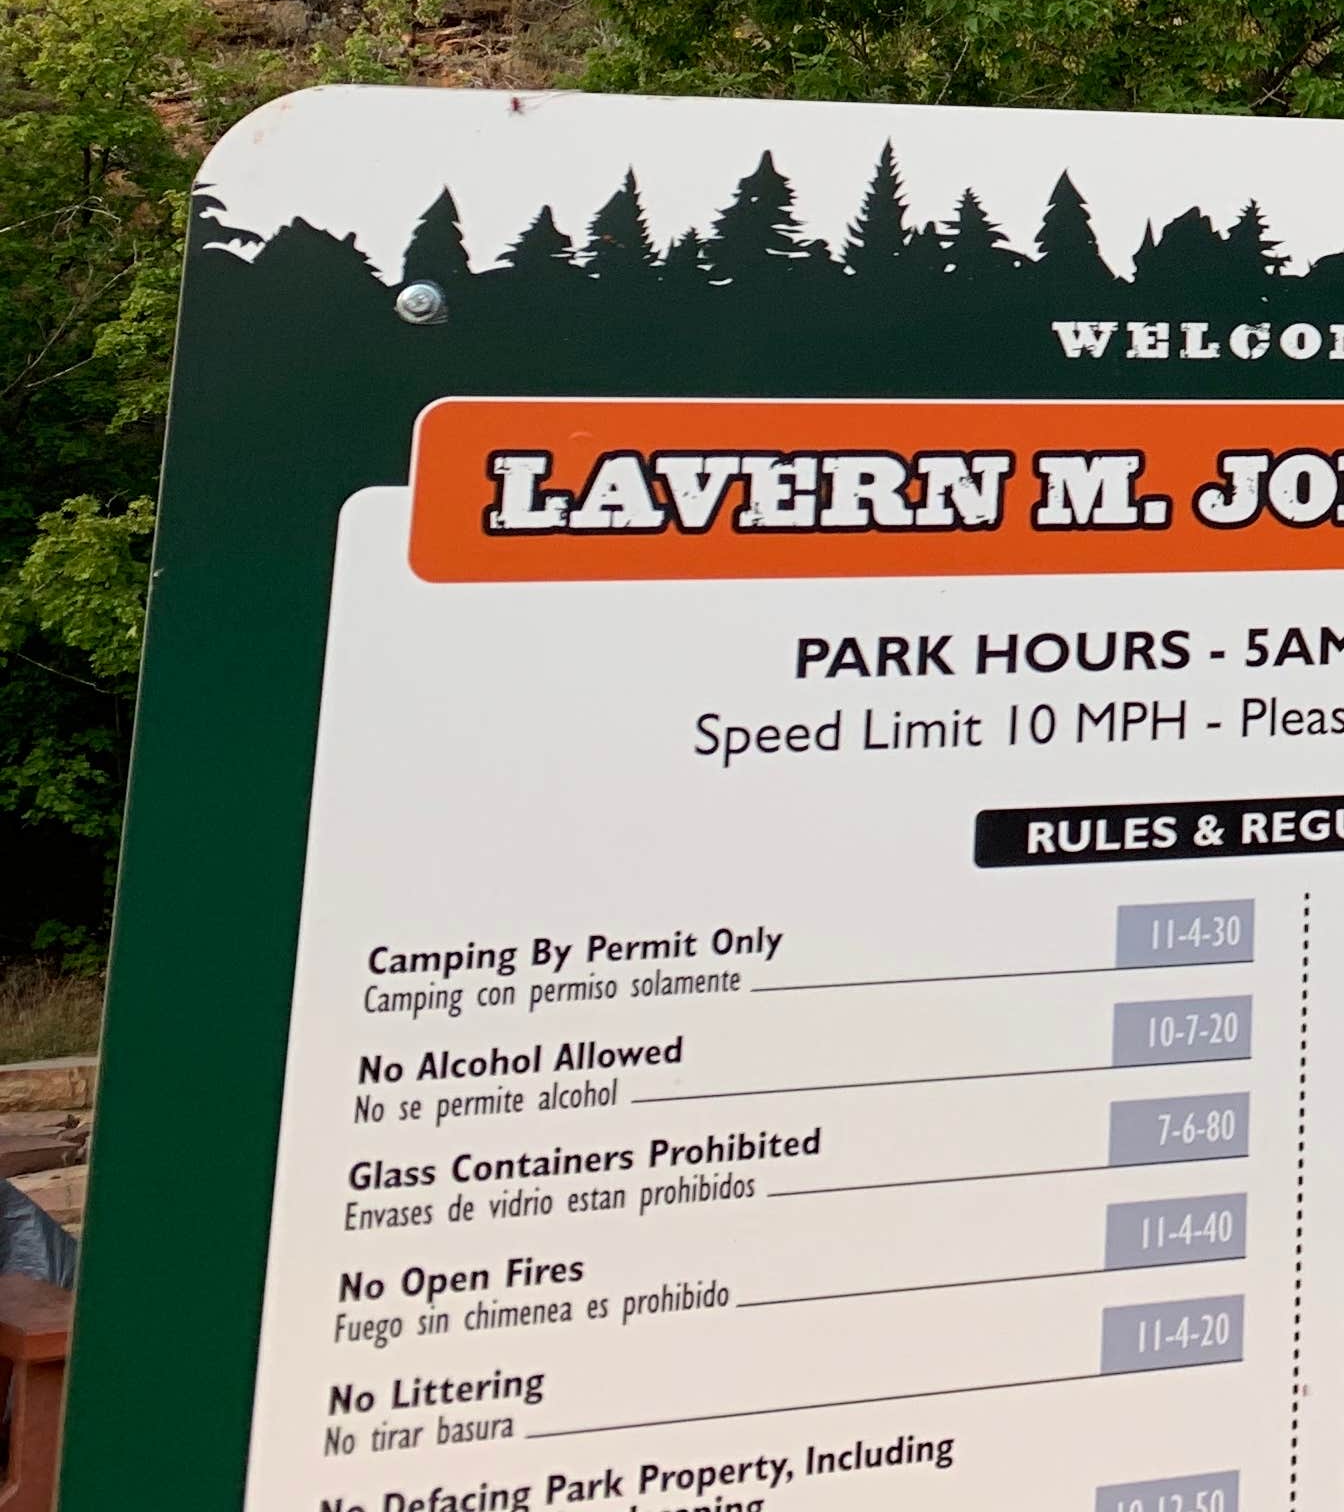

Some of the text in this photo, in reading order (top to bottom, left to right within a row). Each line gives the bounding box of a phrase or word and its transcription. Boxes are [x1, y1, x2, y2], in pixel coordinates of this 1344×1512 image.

[484, 449, 1012, 535] LAVERN
[1031, 449, 1171, 532] M.
[796, 634, 955, 679] PARK
[976, 629, 1191, 675] HOURS
[695, 709, 842, 769] Speed
[863, 708, 983, 750] Limit
[1009, 703, 1056, 746] 10
[1076, 699, 1186, 744] MPH
[1027, 816, 1178, 854] RULES
[1193, 814, 1225, 847] &
[368, 925, 783, 980] Camping By Permit Only
[1152, 915, 1241, 950] 11-4-30
[364, 968, 741, 1021] Camping con permiso solamente
[1149, 1011, 1238, 1048] 10-7-20
[358, 1035, 683, 1085] No Alcohol Allowed
[354, 1077, 618, 1128] No se permite alcohol
[1158, 1109, 1235, 1146] 7-6-80
[348, 1127, 821, 1191] Glass Containers Prohibited
[344, 1171, 755, 1232] Envases de vidrio estan prohibidos
[1142, 1210, 1233, 1249] 11-4-40
[339, 1256, 584, 1304] No Open Fires
[334, 1279, 730, 1350] Fuego sin chimenea es prohibido
[1139, 1312, 1230, 1353] 11-4-20
[329, 1369, 545, 1416] No Littering
[324, 1415, 514, 1457] No tirar basura
[383, 1482, 532, 1512] Defacing
[546, 1468, 624, 1505] Park
[639, 1455, 794, 1497] Property,
[806, 1434, 955, 1476] Including
